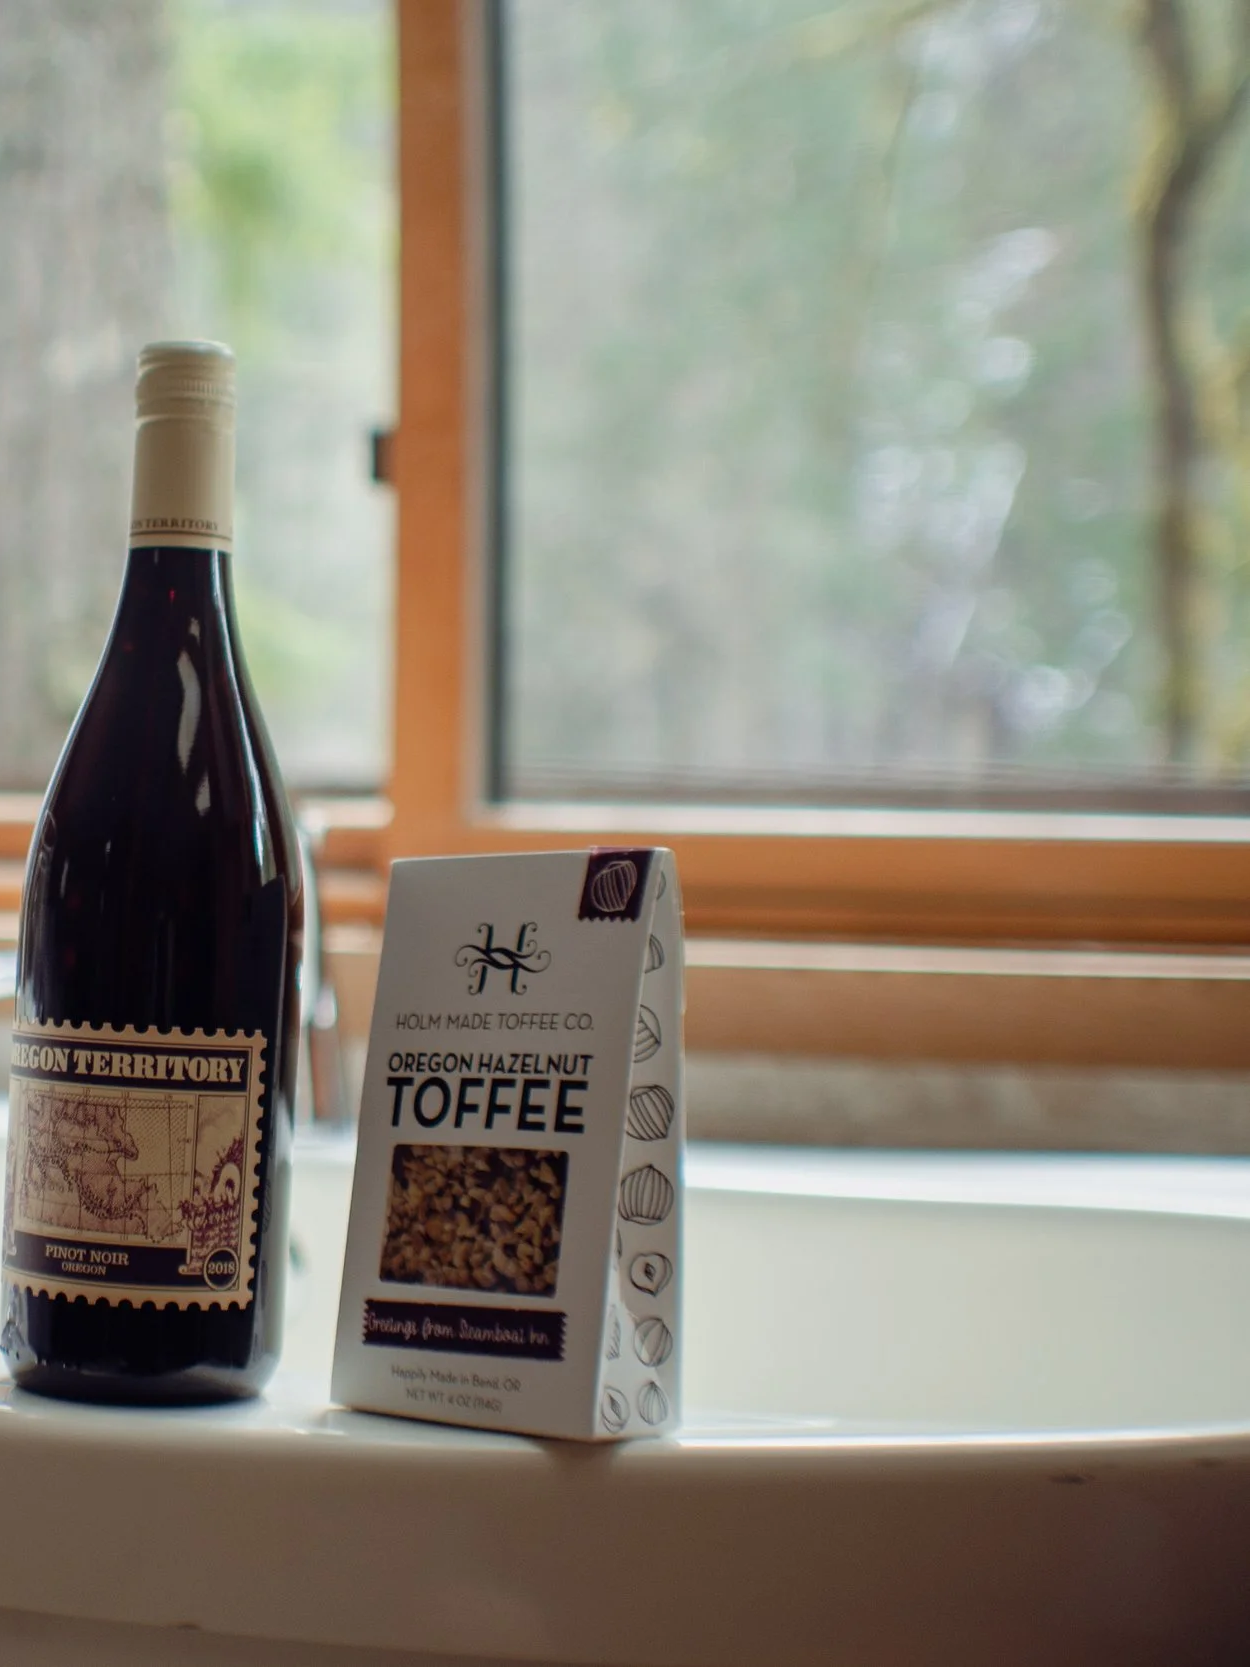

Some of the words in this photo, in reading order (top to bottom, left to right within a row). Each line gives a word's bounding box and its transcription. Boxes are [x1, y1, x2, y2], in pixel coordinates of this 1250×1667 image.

[395, 1012, 441, 1030] HOLM
[447, 1014, 491, 1030] MADE
[498, 1013, 558, 1031] TOFFEE
[564, 1014, 594, 1031] CO.
[11, 1043, 70, 1073] REGON
[73, 1049, 245, 1083] TERRITORY
[388, 1053, 472, 1073] OREGON
[478, 1053, 593, 1075] HAZELNUT
[387, 1077, 589, 1134] TOFFEE
[45, 1244, 87, 1262] PINOT
[90, 1250, 130, 1266] NOIR
[61, 1262, 107, 1276] OREGON
[207, 1263, 235, 1275] 2018
[367, 1311, 417, 1340] Greetings
[422, 1316, 454, 1340] from
[459, 1317, 525, 1345] Steamboat
[391, 1364, 426, 1382] Happily
[430, 1369, 457, 1384] Made
[503, 1377, 521, 1392] OR
